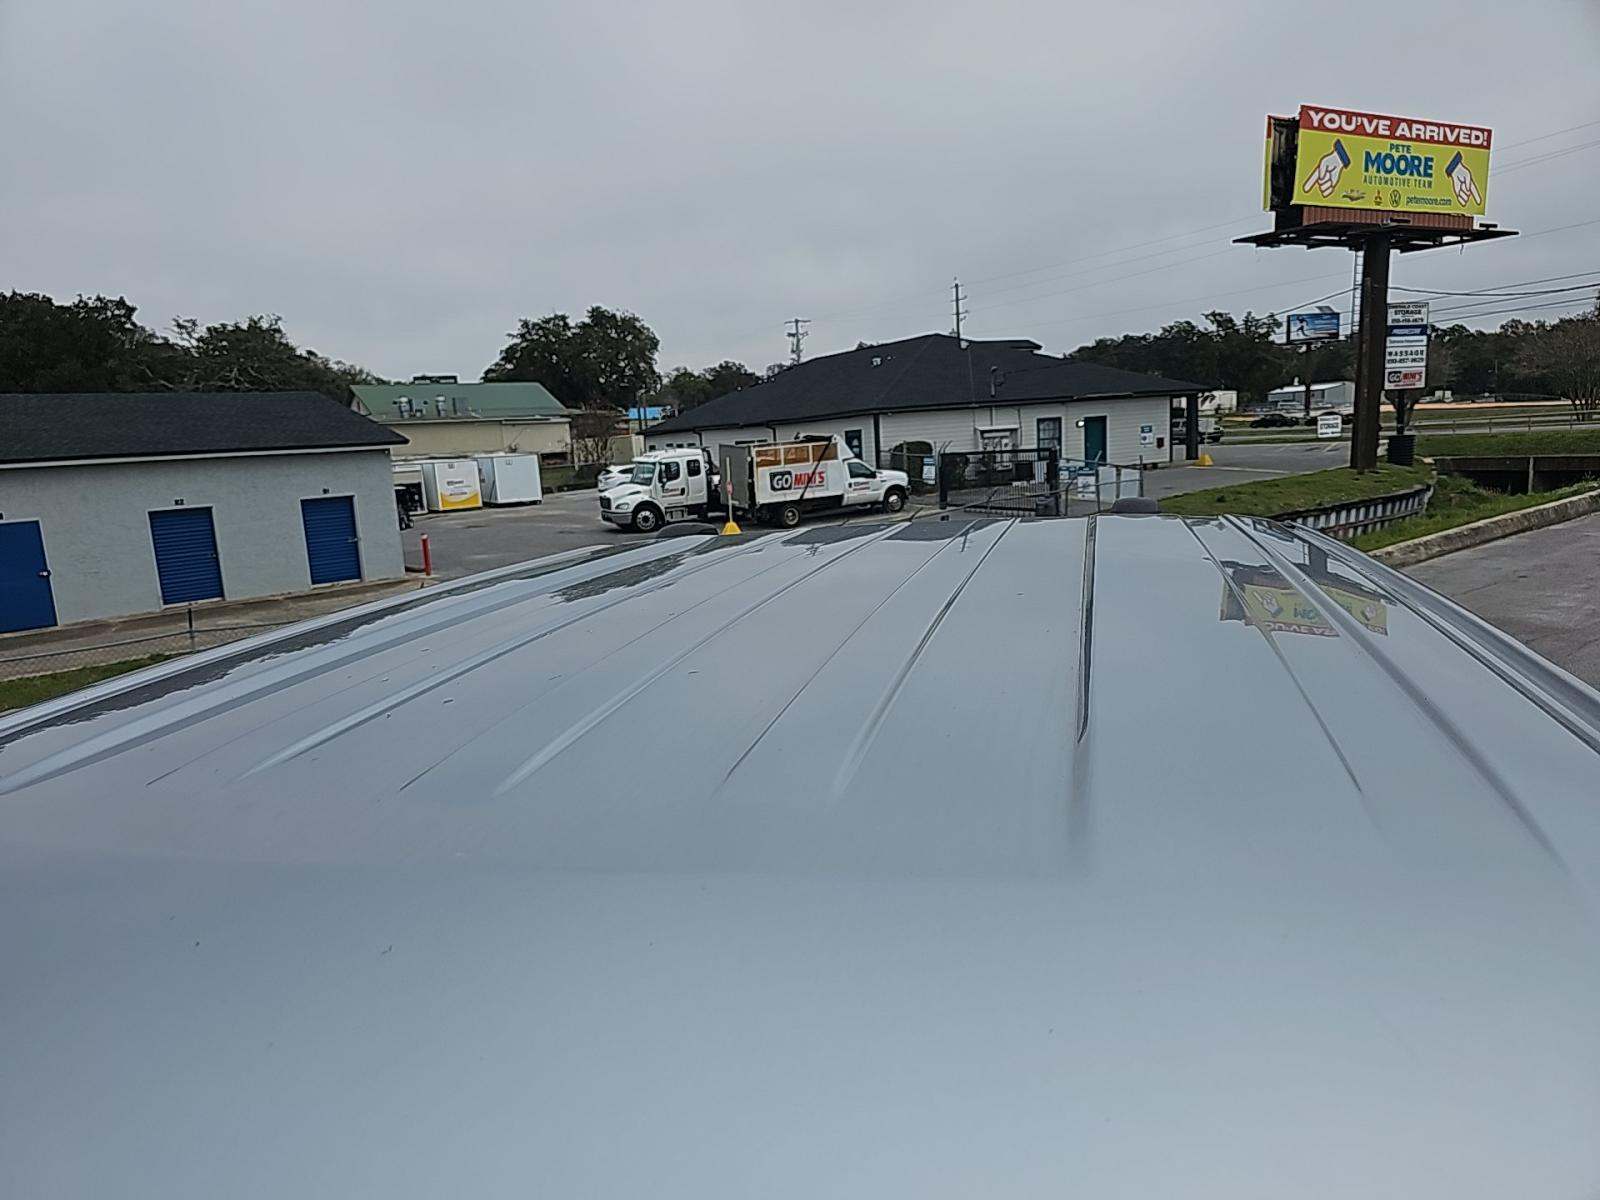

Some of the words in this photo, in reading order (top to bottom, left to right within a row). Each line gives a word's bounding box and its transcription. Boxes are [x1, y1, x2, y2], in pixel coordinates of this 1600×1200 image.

[1307, 109, 1391, 136] YOU'VE
[1395, 122, 1488, 146] ARRIVED!
[1389, 143, 1412, 154] PETE
[1364, 150, 1434, 178] MOORE
[1363, 175, 1411, 188] AUTOMOTIVE
[1414, 178, 1433, 190] TEAM
[1406, 195, 1452, 207] petemoore.com
[773, 475, 792, 489] GO
